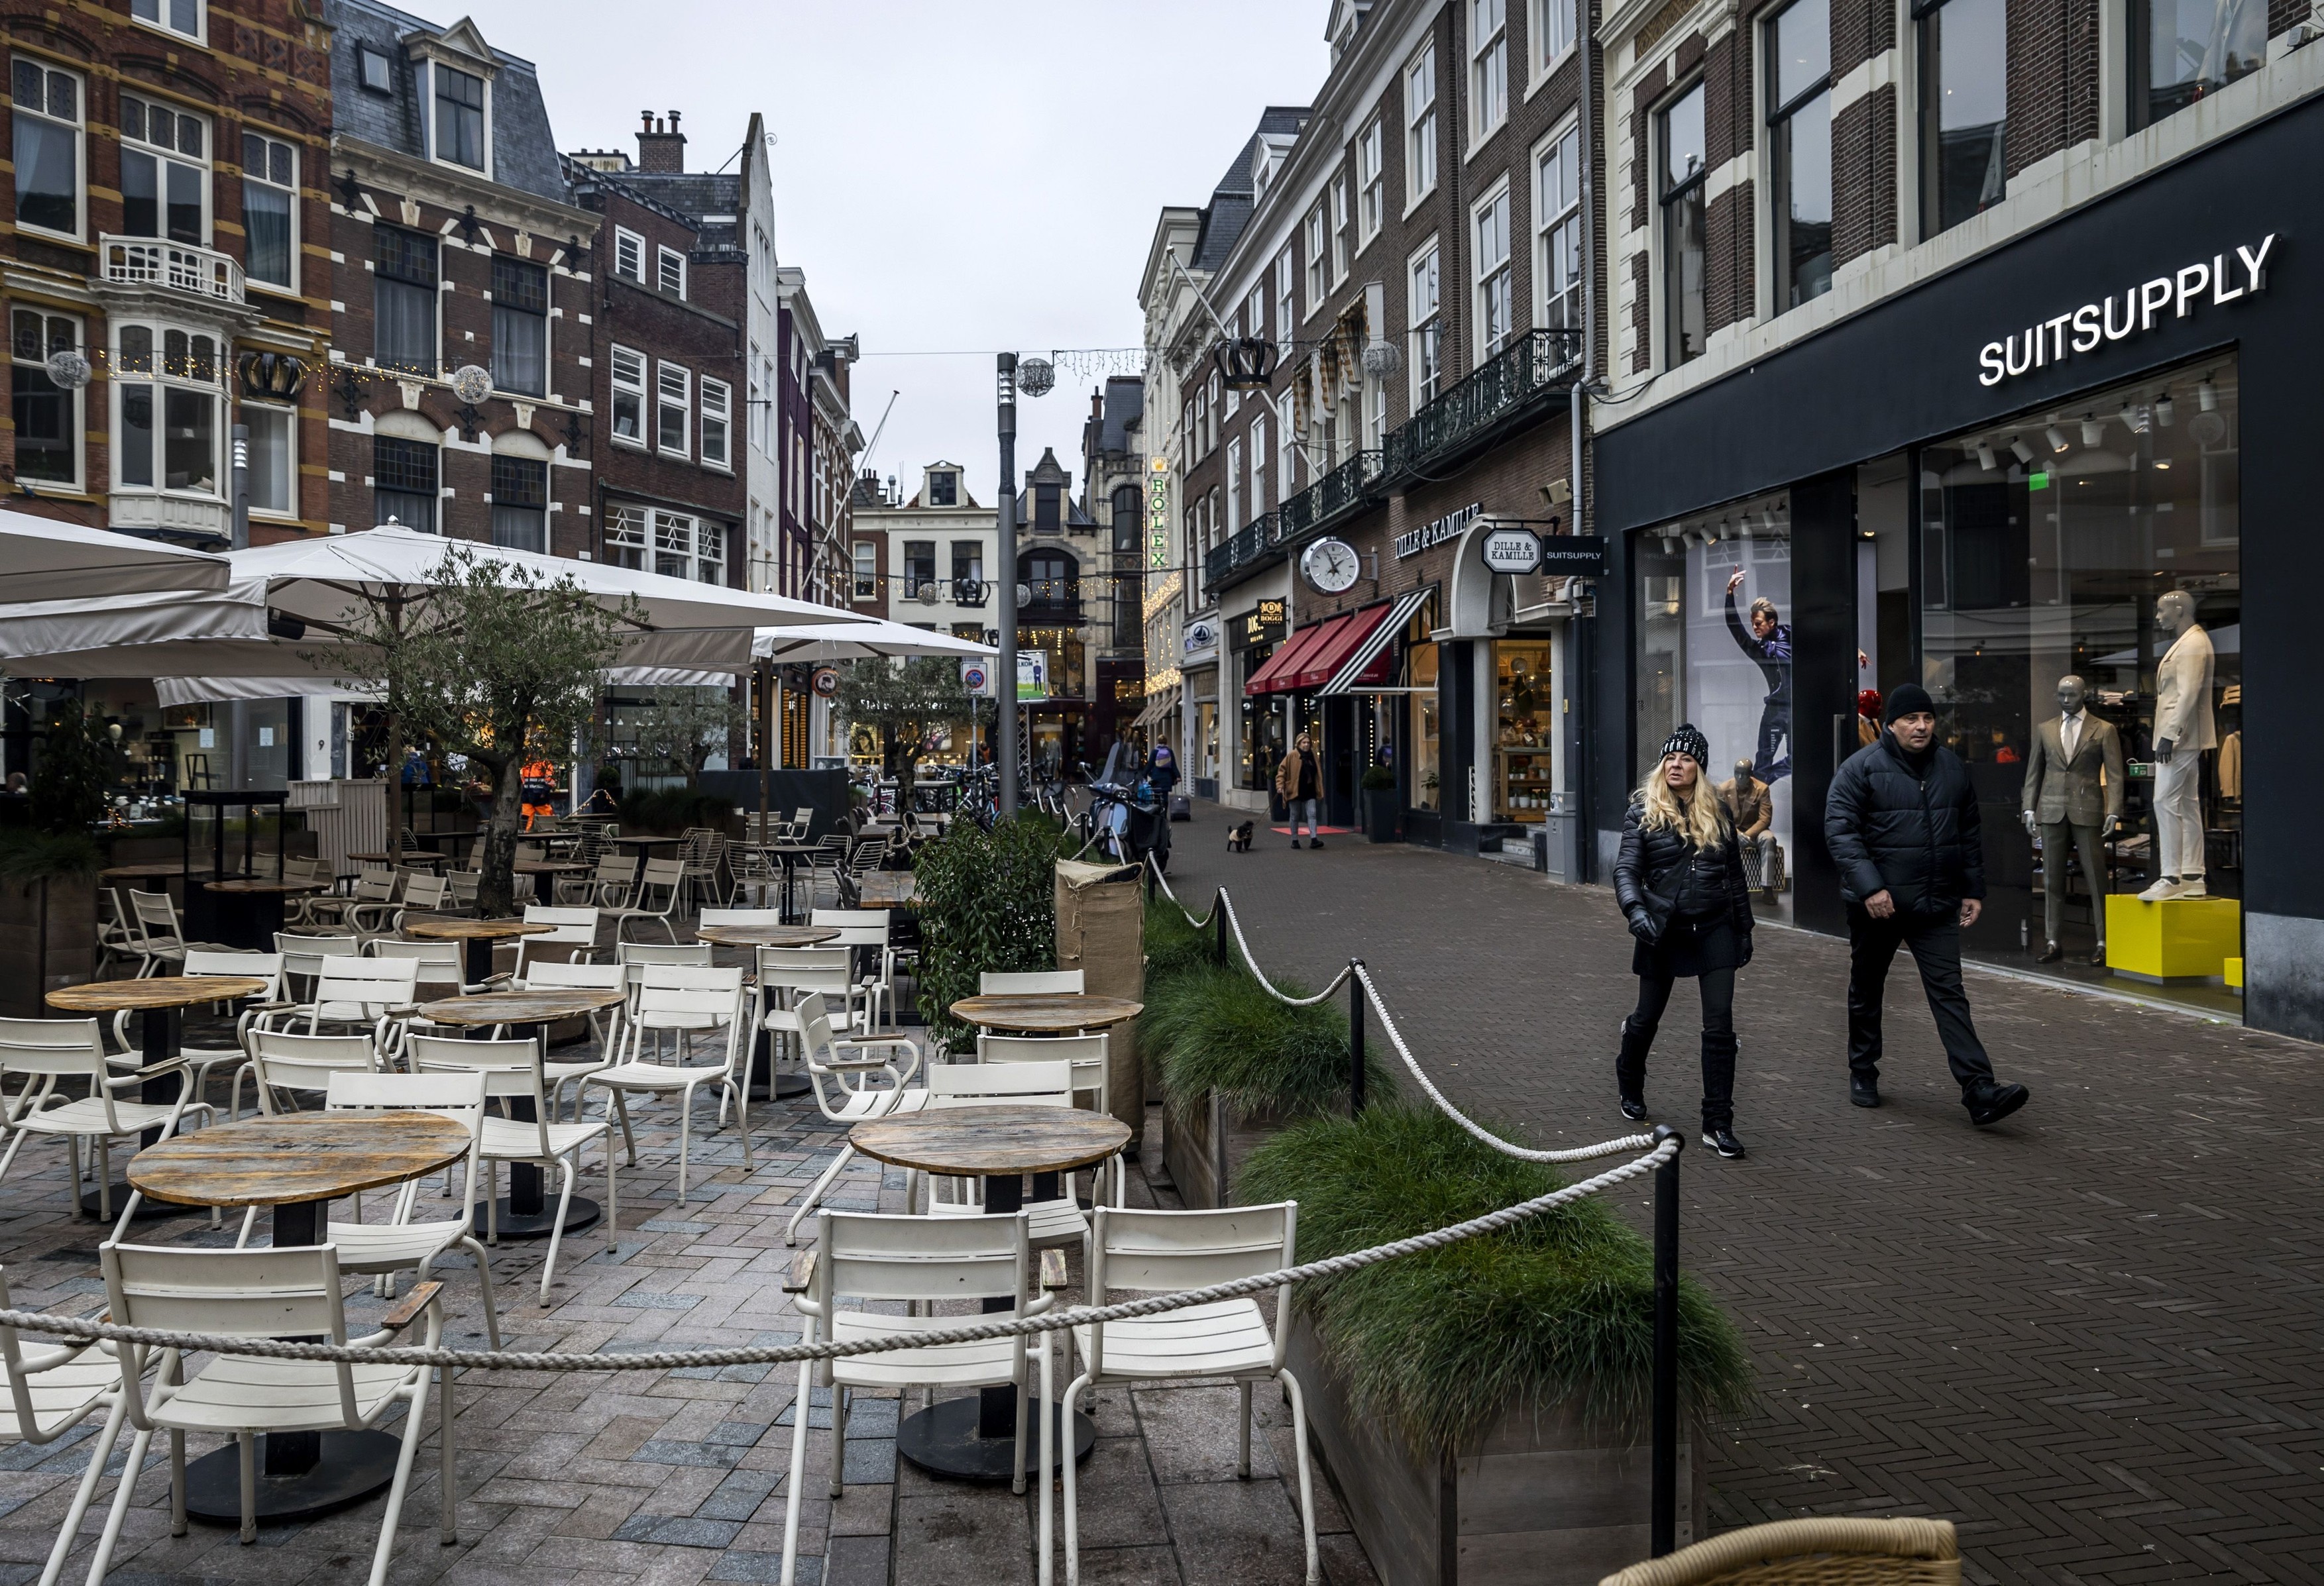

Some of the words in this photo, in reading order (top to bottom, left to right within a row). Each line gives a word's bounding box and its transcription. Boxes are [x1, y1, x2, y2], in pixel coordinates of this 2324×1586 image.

[1979, 233, 2276, 386] SUITSUPPLY
[1152, 479, 1164, 565] ROLEX
[1395, 529, 1419, 559] DILLE
[1421, 525, 1429, 549] &
[1431, 502, 1478, 545] KAMILLE
[1494, 541, 1522, 551] DILLE
[1524, 542, 1532, 551] &
[1491, 551, 1534, 560] KAMILLE
[1547, 551, 1601, 560] SUITSUPPLY
[1248, 615, 1264, 634] BOG
[319, 739, 325, 751] 9
